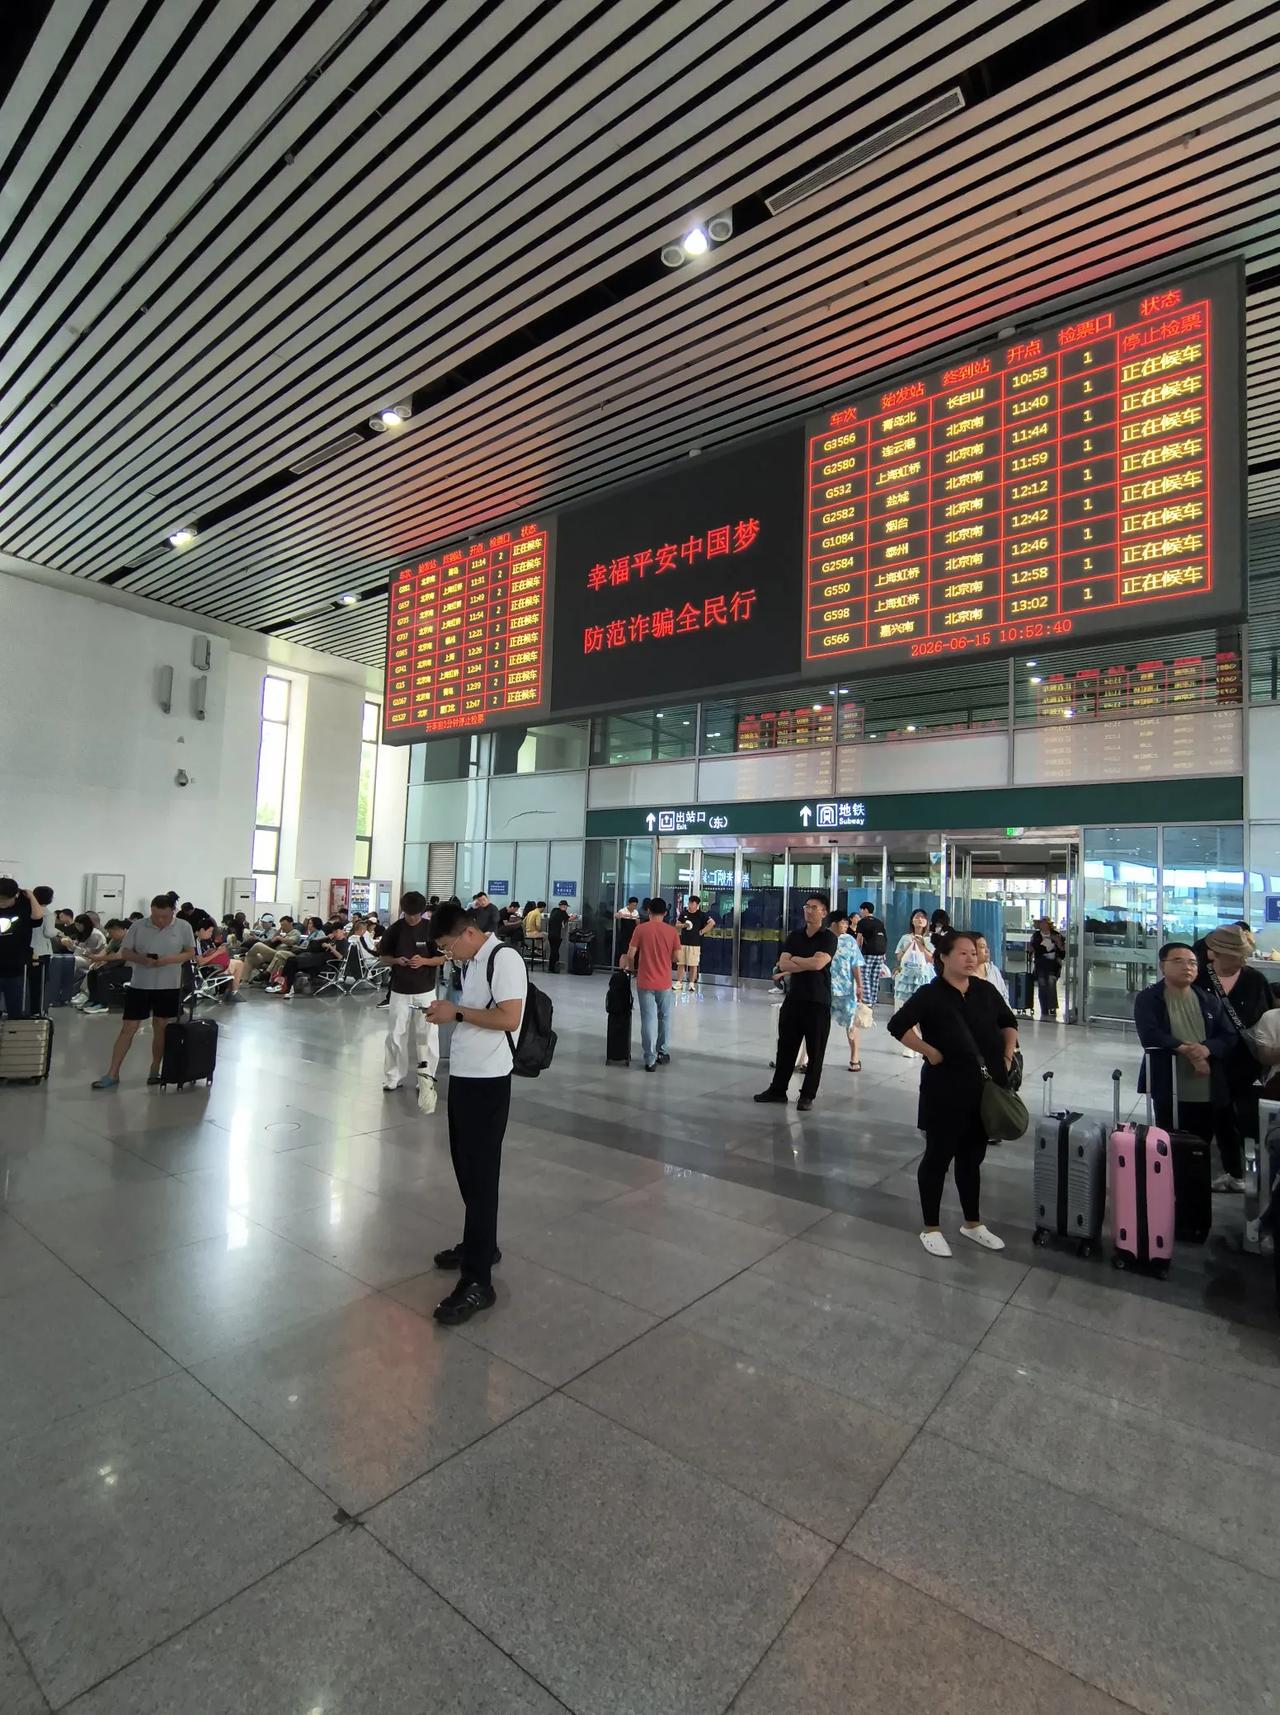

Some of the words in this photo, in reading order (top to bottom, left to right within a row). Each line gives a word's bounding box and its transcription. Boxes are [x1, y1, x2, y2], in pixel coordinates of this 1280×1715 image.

[830, 408, 856, 426] 车次
[881, 382, 924, 408] 始发站
[943, 359, 990, 386] 终到站
[1007, 340, 1041, 364] 开点
[1058, 313, 1113, 346] 检票口
[1140, 289, 1182, 317] 状态
[824, 433, 855, 451] G3566
[882, 412, 916, 432] 青岛北
[947, 388, 984, 409] 长白山
[1013, 367, 1048, 387] 10:53
[1084, 352, 1092, 363] 1
[1123, 312, 1203, 352] 停止检票
[824, 458, 855, 475] G2580
[882, 438, 916, 457] 连云港
[946, 416, 984, 436] 北京南
[1013, 395, 1048, 415] 11:40
[1084, 381, 1092, 392] 1
[1121, 344, 1201, 382] 正在候车
[826, 483, 851, 498] G532
[876, 462, 921, 485] 上海虹桥
[946, 443, 984, 463] 北京南
[1012, 423, 1048, 443] 11:44
[1084, 410, 1092, 422] 1
[1121, 376, 1202, 412] 正在候车
[823, 507, 854, 523] G2582
[886, 491, 909, 507] 盐城
[946, 471, 983, 490] 北京南
[1012, 452, 1048, 471] 11:59
[1084, 440, 1092, 451] 1
[1121, 407, 1202, 442] 正在候车
[822, 532, 853, 548] G1084
[886, 518, 908, 533] 烟台
[945, 498, 983, 516] 北京南
[1012, 480, 1048, 499] 12:12
[1084, 469, 1092, 480] 1
[1121, 439, 1202, 472] 正在候车
[520, 524, 537, 538] 状态
[822, 557, 854, 573] G2584
[885, 543, 908, 558] 泰州
[945, 525, 983, 543] 北京南
[1012, 509, 1048, 527] 12:42
[1084, 498, 1093, 510] 1
[1121, 471, 1202, 503] 正在候车
[513, 538, 542, 556] 正在候车
[587, 518, 760, 591] 幸福平安中国梦
[824, 583, 850, 596] G550
[874, 567, 920, 586] 上海虹桥
[945, 553, 983, 570] 北京南
[1012, 538, 1048, 556] 12:46
[1084, 528, 1092, 540] 1
[1121, 503, 1203, 533] 正在候车
[512, 557, 541, 574] 正在候车
[824, 608, 850, 621] G598
[874, 593, 920, 612] 上海虹桥
[945, 580, 983, 597] 北京南
[1012, 567, 1048, 584] 12:58
[1084, 558, 1093, 569] 1
[1121, 534, 1203, 564] 正在候车
[511, 576, 540, 593] 正在候车
[511, 595, 540, 611] 正在候车
[824, 633, 849, 646] G566
[880, 621, 914, 638] 嘉兴南
[945, 608, 983, 624] 北京南
[1012, 596, 1048, 612] 13:02
[1084, 588, 1092, 599] 1
[1122, 566, 1203, 594] 正在候车
[510, 614, 539, 629] 正在候车
[584, 589, 757, 655] 防范诈骗全民行
[509, 632, 538, 647] 正在候车
[912, 632, 990, 657] 2026-06-15
[1000, 619, 1072, 643] 10:52:40
[509, 651, 538, 666] 正在候车
[508, 669, 537, 684] 正在候车
[507, 688, 536, 703] 正在候车
[676, 811, 706, 823] 出站口
[839, 803, 865, 816] 地铁
[839, 817, 865, 826] Subway
